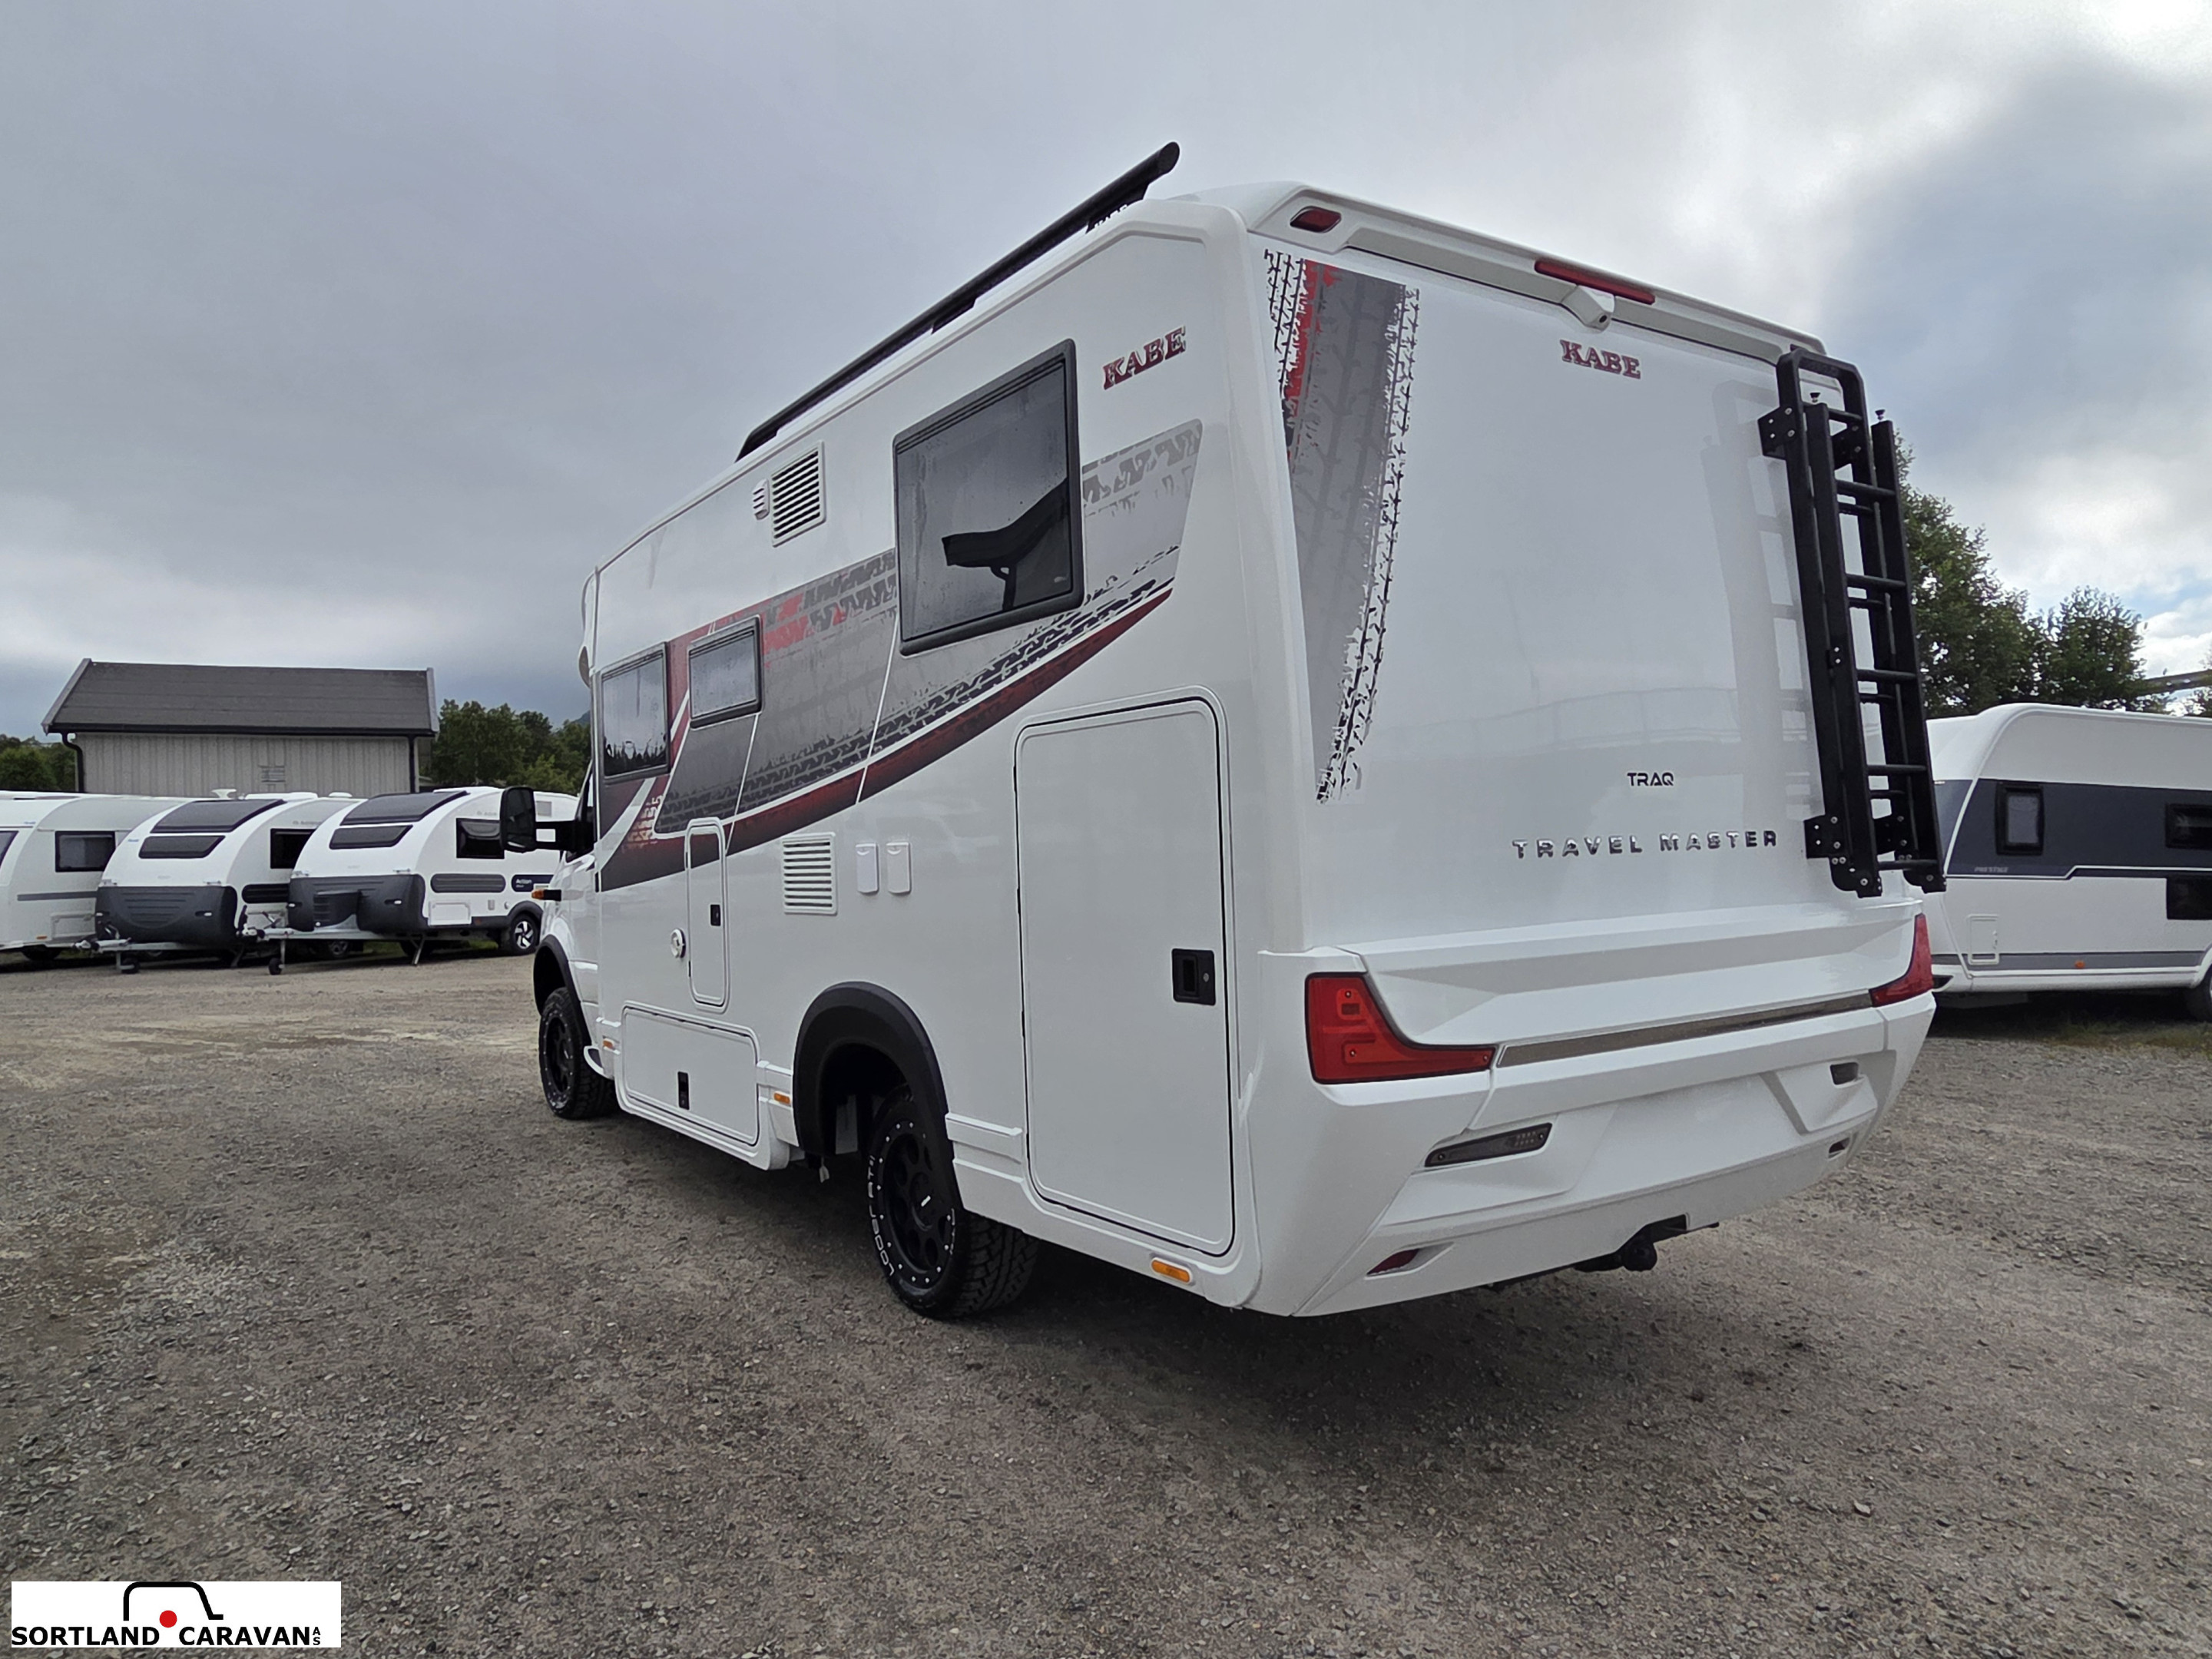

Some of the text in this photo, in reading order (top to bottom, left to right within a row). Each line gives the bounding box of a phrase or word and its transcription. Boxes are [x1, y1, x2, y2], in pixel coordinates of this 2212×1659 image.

[1103, 326, 1186, 390] KABE
[1559, 339, 1641, 379] KABE
[1627, 772, 1674, 786] TRAQ
[1512, 830, 1777, 859] TRAVEL MASTER
